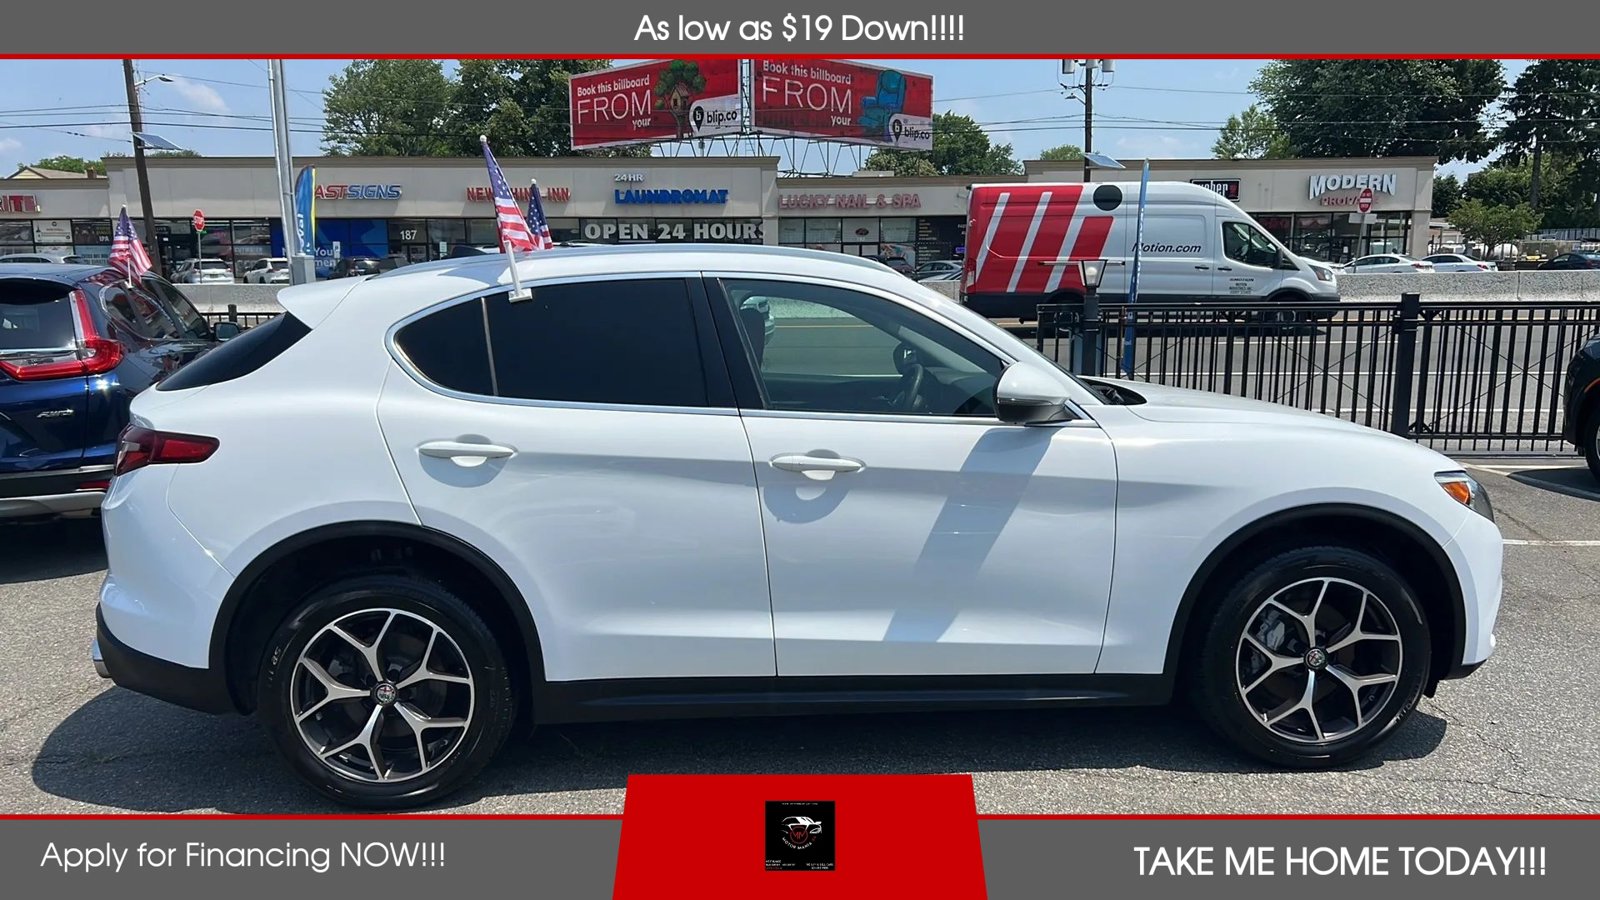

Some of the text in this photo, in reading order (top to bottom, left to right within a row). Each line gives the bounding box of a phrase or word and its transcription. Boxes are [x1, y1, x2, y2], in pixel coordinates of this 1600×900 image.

[763, 60, 852, 85] Book this billboard
[577, 74, 650, 97] Book this billboard
[762, 75, 852, 115] FROM
[577, 89, 651, 125] FROM
[632, 119, 651, 131] your
[706, 110, 738, 126] blip.co
[831, 114, 852, 127] your
[904, 126, 930, 141] blip.co
[314, 184, 402, 200] ASTSIGNS
[547, 187, 570, 202] INN
[1308, 174, 1397, 200] MODERN
[614, 188, 729, 205] LAUNDROMAT
[778, 193, 922, 210] LUCKY NAIL & SPA
[400, 230, 418, 240] 187
[584, 223, 649, 240] OPEN
[657, 223, 686, 240] 24
